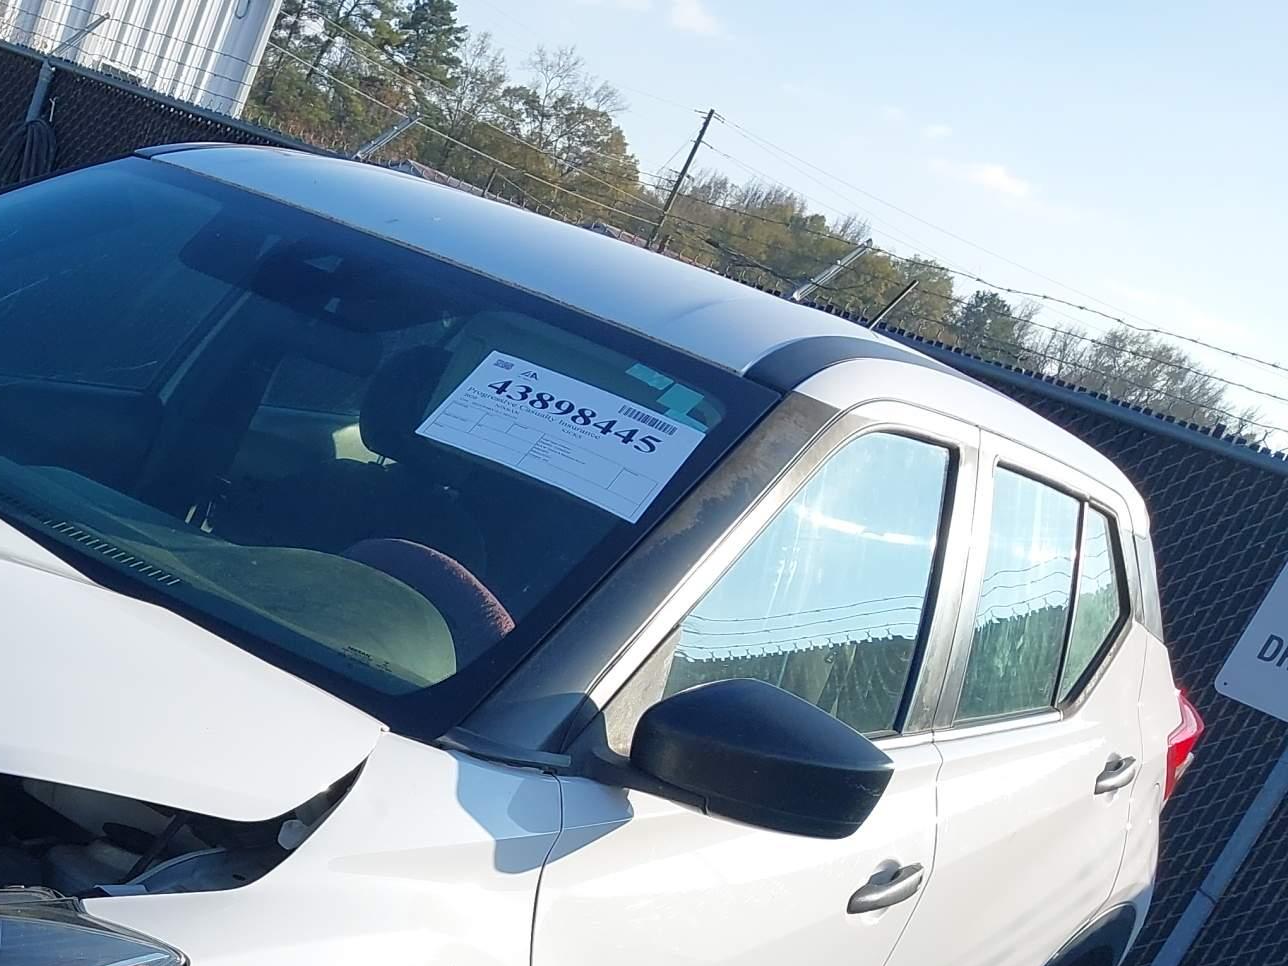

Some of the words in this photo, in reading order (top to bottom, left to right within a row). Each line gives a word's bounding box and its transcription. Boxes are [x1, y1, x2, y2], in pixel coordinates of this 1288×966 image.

[467, 387, 517, 407] Progressive
[520, 405, 553, 422] Casualty
[559, 420, 600, 439] Insurance
[487, 379, 665, 454] 43898445
